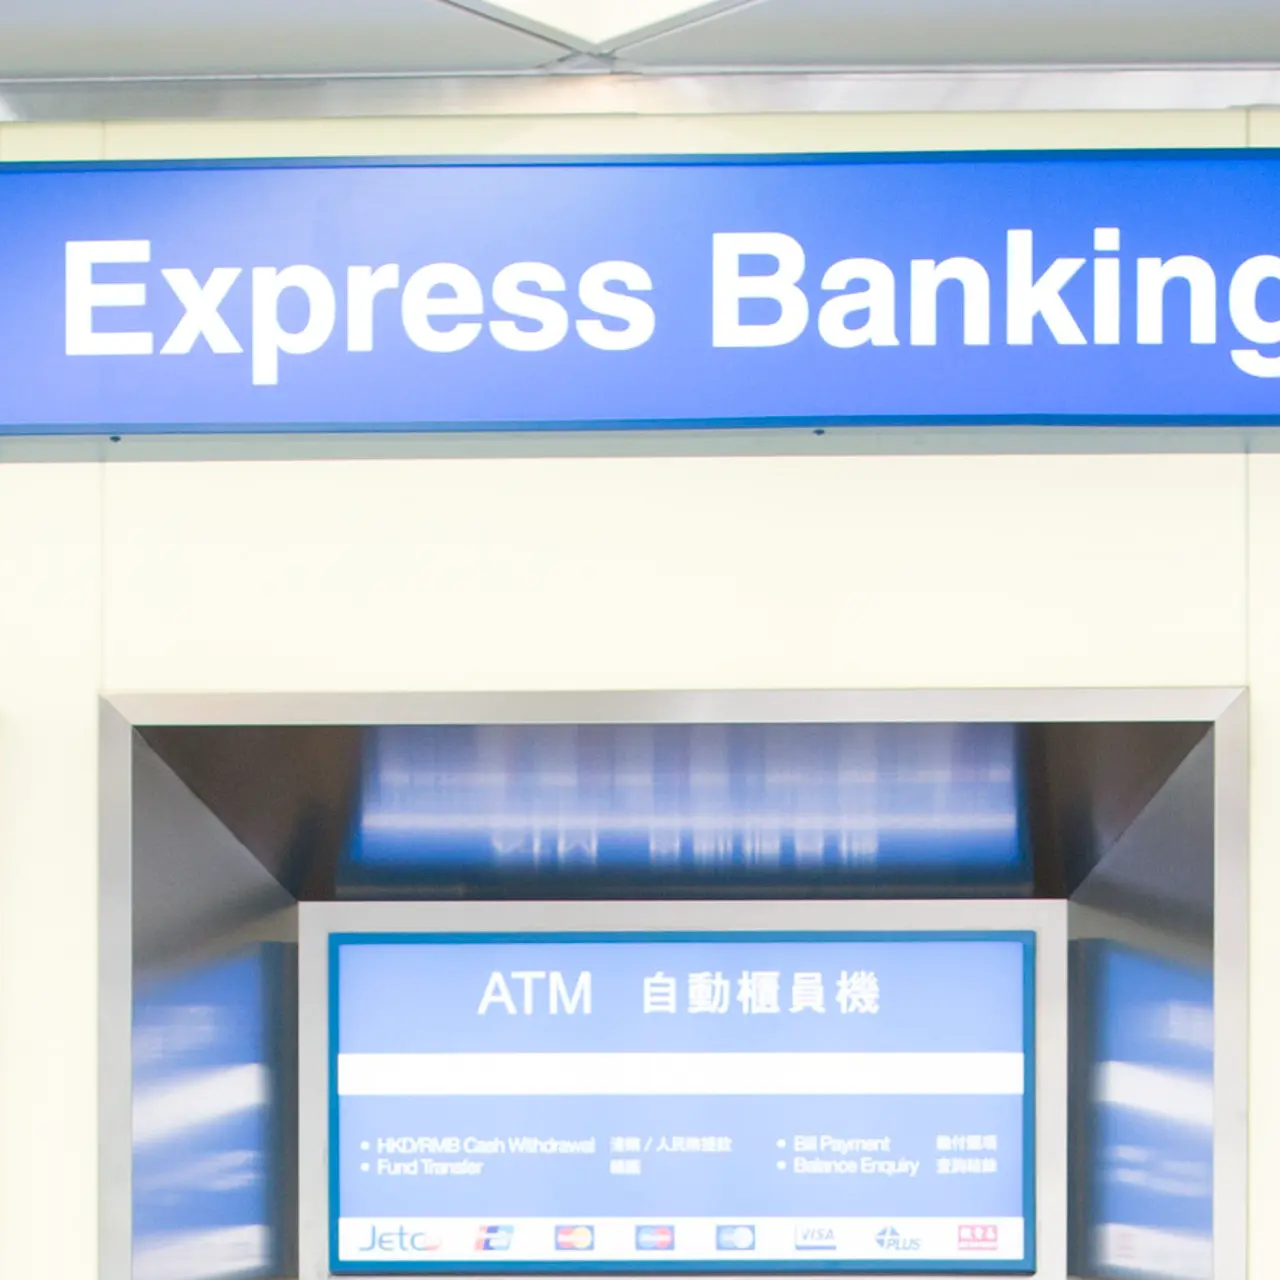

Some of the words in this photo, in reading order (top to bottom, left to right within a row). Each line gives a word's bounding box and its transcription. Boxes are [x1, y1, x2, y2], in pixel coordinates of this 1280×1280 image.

[63, 239, 655, 386] Express
[477, 971, 593, 1015] ATM
[642, 971, 881, 1014] 自動櫃員機
[377, 1136, 460, 1154] HKD/RMB
[463, 1136, 506, 1153] Cash
[508, 1136, 596, 1153] Withdrawal
[793, 1134, 818, 1151] Bill
[820, 1135, 892, 1155] Payment
[377, 1158, 418, 1175] Fund
[422, 1158, 484, 1175] Transfer
[793, 1157, 858, 1173] Balance
[860, 1157, 920, 1177] Enquiry
[801, 1228, 835, 1241] VISA
[886, 1238, 922, 1251] PLUS
